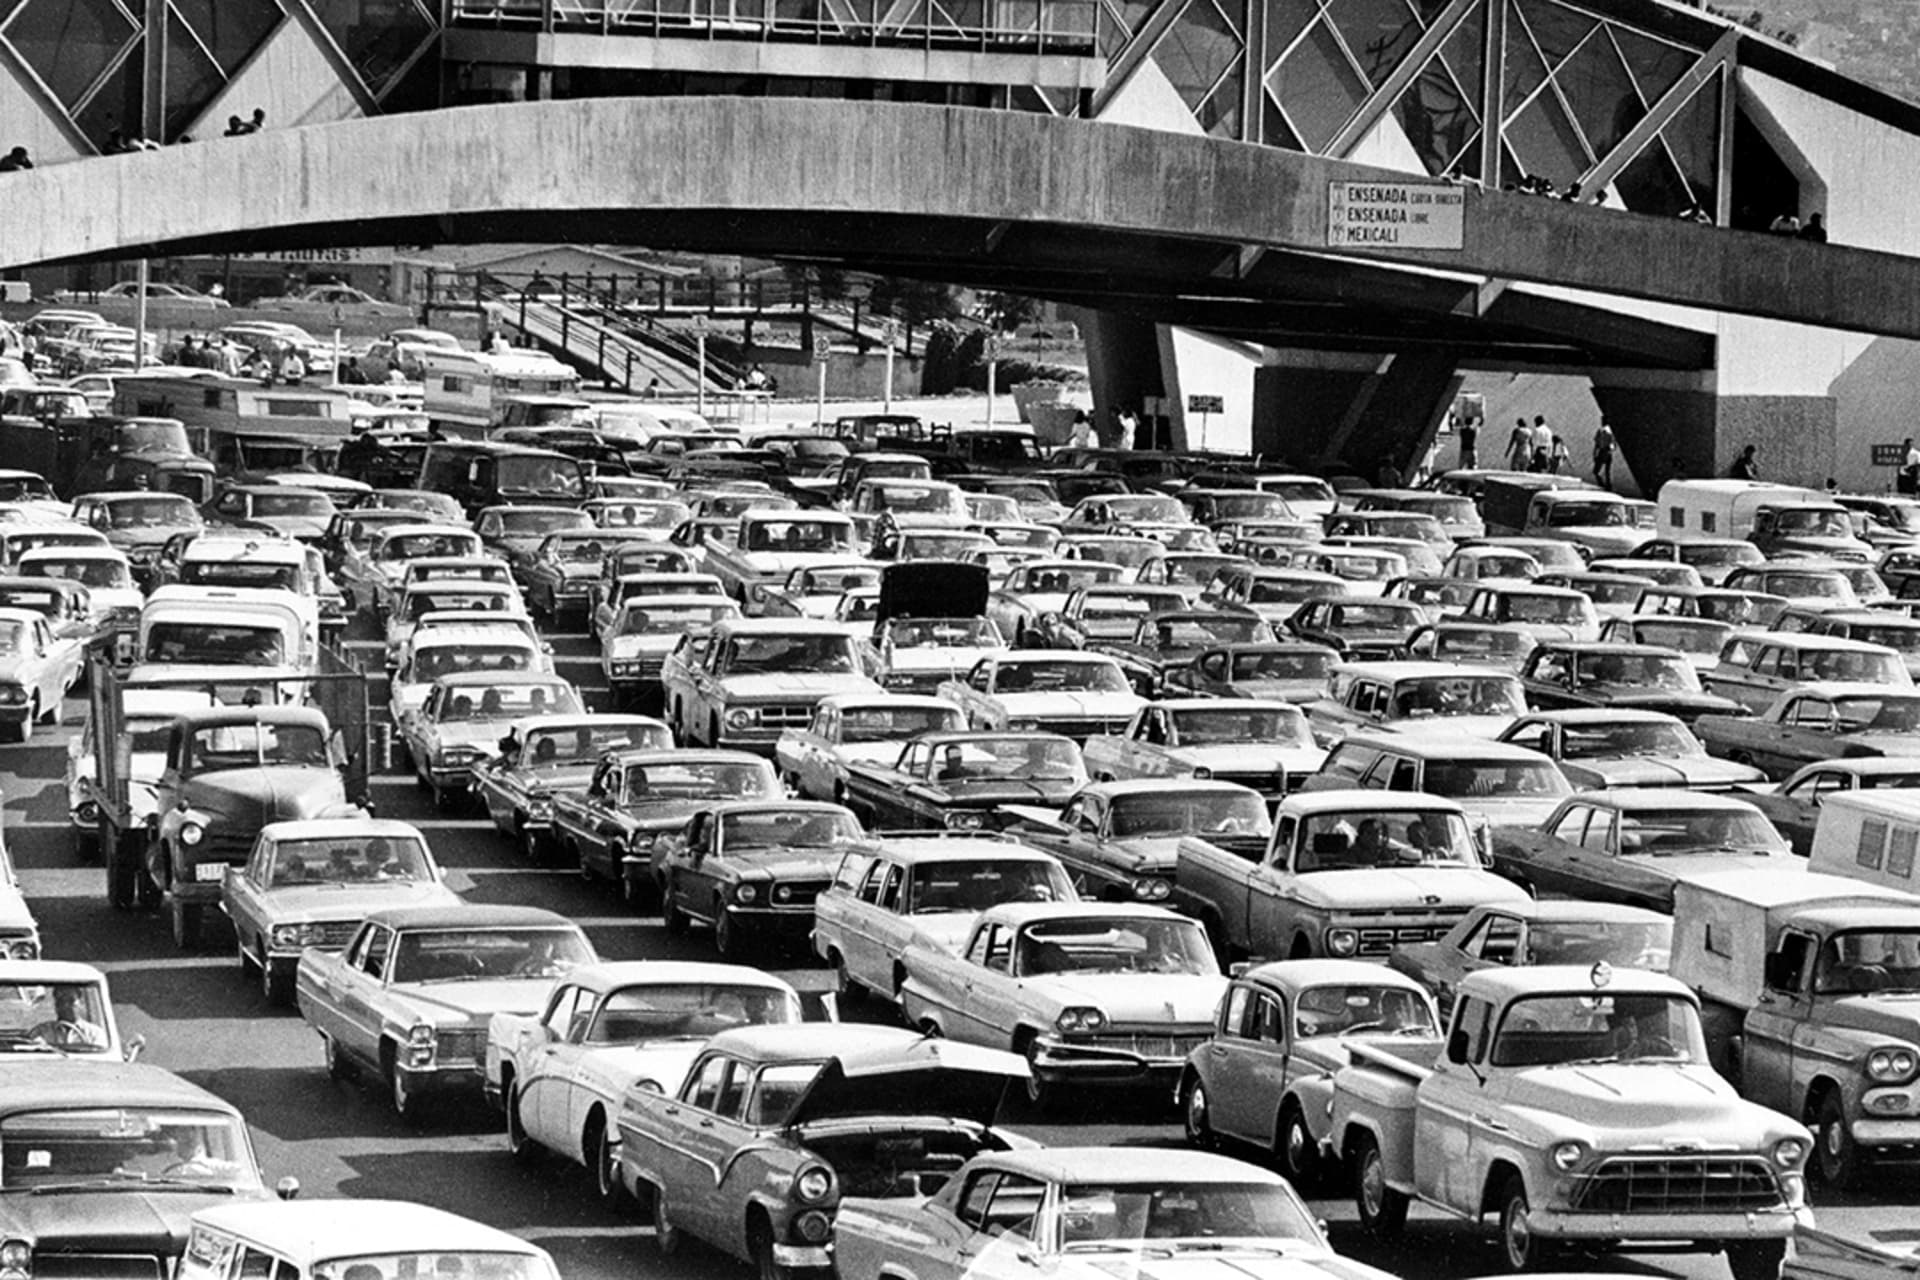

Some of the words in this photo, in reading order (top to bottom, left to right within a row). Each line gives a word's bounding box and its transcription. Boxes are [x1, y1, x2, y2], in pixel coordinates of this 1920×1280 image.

[1348, 187, 1407, 204] ENSENADA
[1347, 207, 1407, 223] ENSENADA
[1347, 227, 1398, 242] MEXICALI
